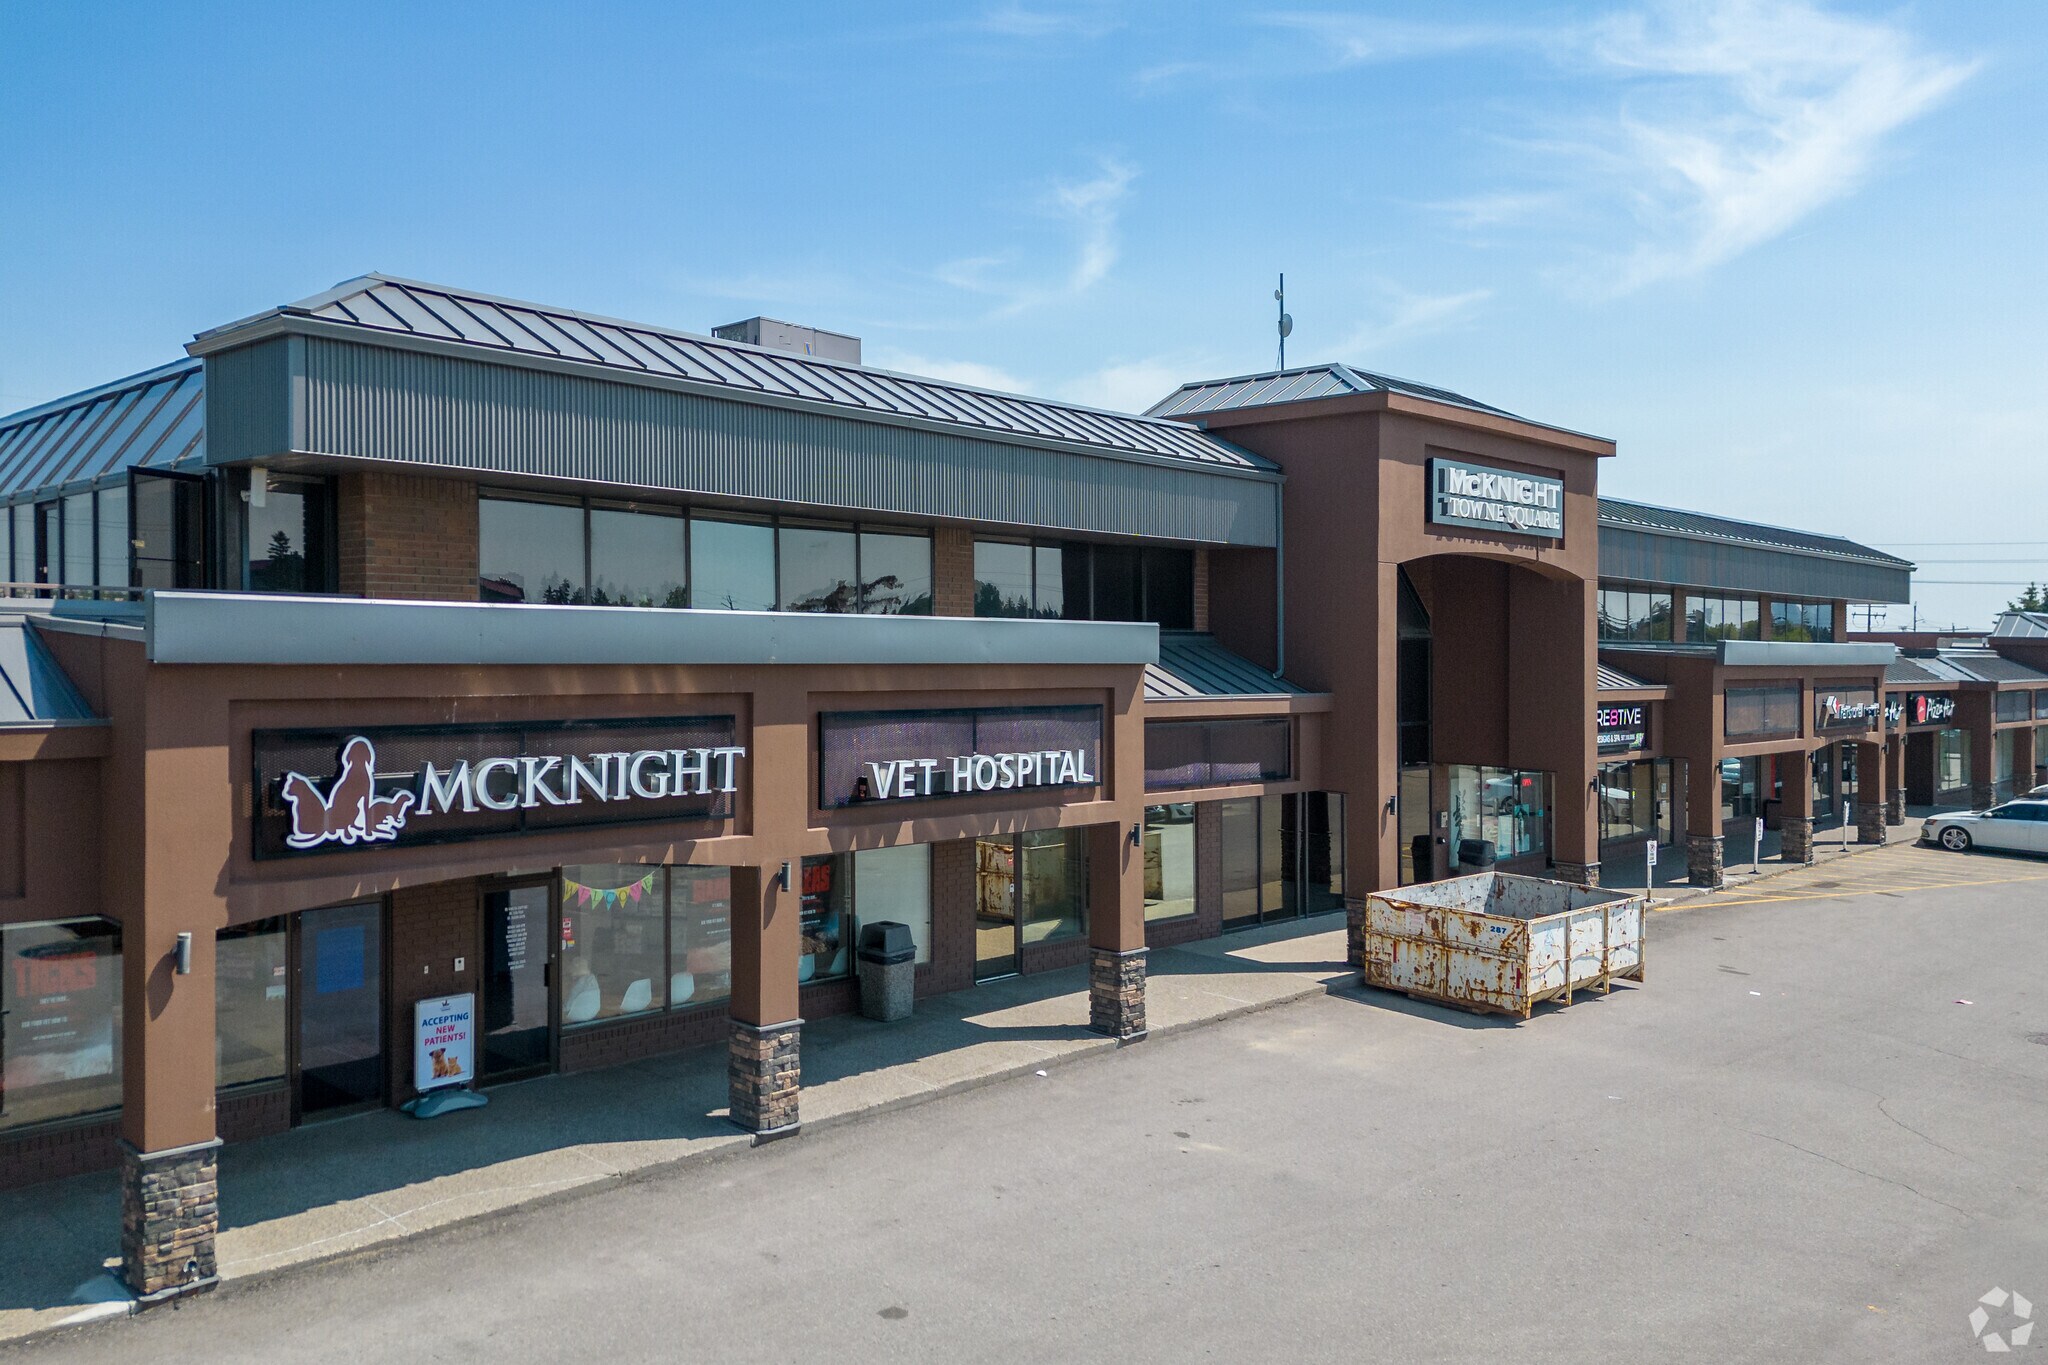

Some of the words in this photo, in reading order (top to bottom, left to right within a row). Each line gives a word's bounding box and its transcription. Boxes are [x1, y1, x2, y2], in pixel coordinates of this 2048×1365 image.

[1447, 467, 1561, 509] McKNIGHT
[1448, 498, 1505, 522] TOWNE
[1505, 506, 1561, 530] SQUARE
[1597, 708, 1641, 726] RE8TIVE
[868, 759, 938, 799] VET
[949, 749, 1094, 793] HOSPITAL
[1490, 925, 1506, 934] 287
[422, 1012, 469, 1027] ACCEPTING
[436, 1024, 455, 1034] NEW
[424, 1032, 466, 1046] PATIENTS!
